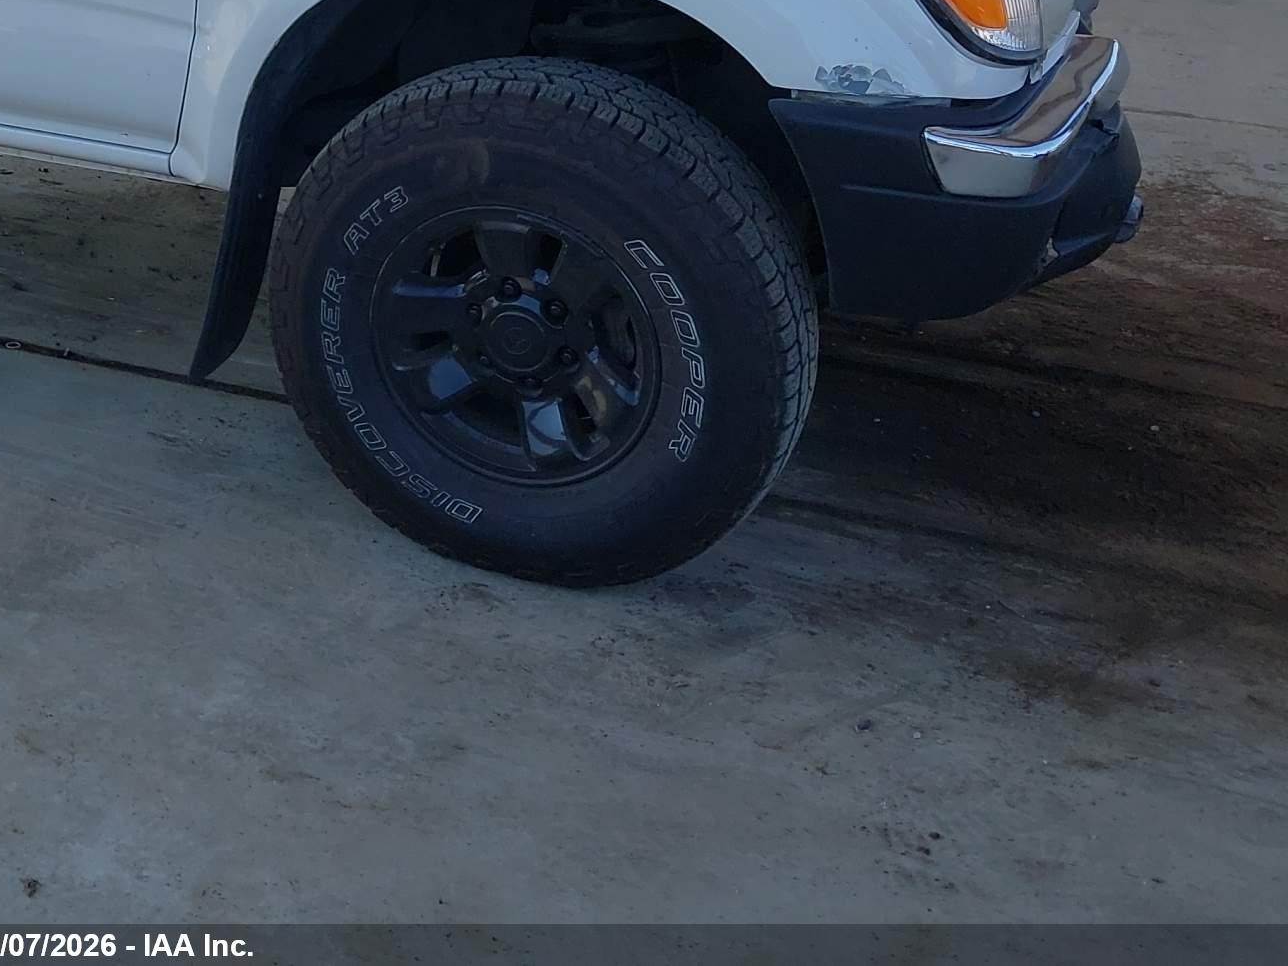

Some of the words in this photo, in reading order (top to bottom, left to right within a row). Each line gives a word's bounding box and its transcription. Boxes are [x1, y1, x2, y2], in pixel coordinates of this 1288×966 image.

[343, 185, 410, 256] AT3
[320, 267, 483, 524] DISCOVERER
[622, 238, 706, 463] COOPER
